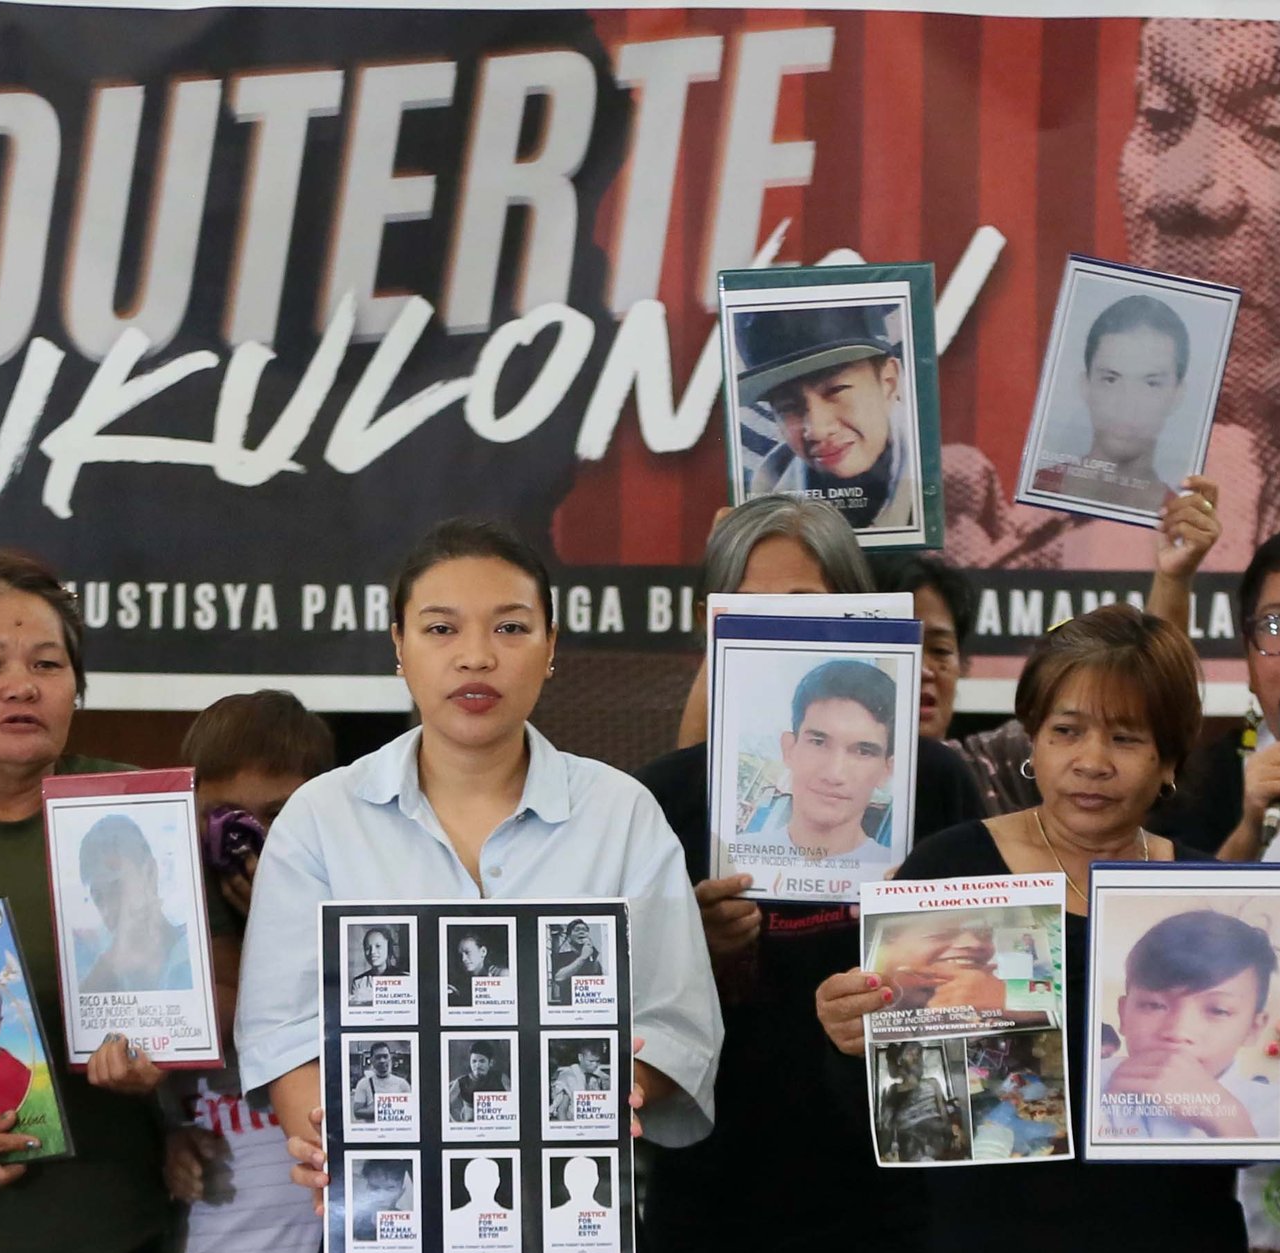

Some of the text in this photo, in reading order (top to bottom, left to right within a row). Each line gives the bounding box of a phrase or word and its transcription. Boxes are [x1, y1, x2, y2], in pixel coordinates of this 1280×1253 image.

[828, 487, 863, 498] DAVID
[67, 582, 278, 630] USTISYA
[302, 584, 389, 631] PAR
[550, 586, 624, 632] GA
[728, 843, 828, 857] BERNARD NONAY
[728, 855, 749, 865] DATE
[786, 878, 852, 893] RISE UP
[885, 885, 937, 895] PINATAY
[944, 883, 958, 892] SA
[962, 881, 1009, 891] BAGONG
[1012, 879, 1055, 888] SILANG
[919, 896, 1010, 908] CALOOCAN CITY
[769, 905, 845, 930] Ecumenical
[112, 995, 137, 1005] BALLA
[871, 1005, 975, 1020] SONNY ESPINOSA
[872, 1016, 903, 1027] DATE OF
[924, 1023, 977, 1031] NOVEMBER
[152, 1037, 170, 1050] UP
[1100, 1093, 1221, 1105] ANGELITO SORIANO
